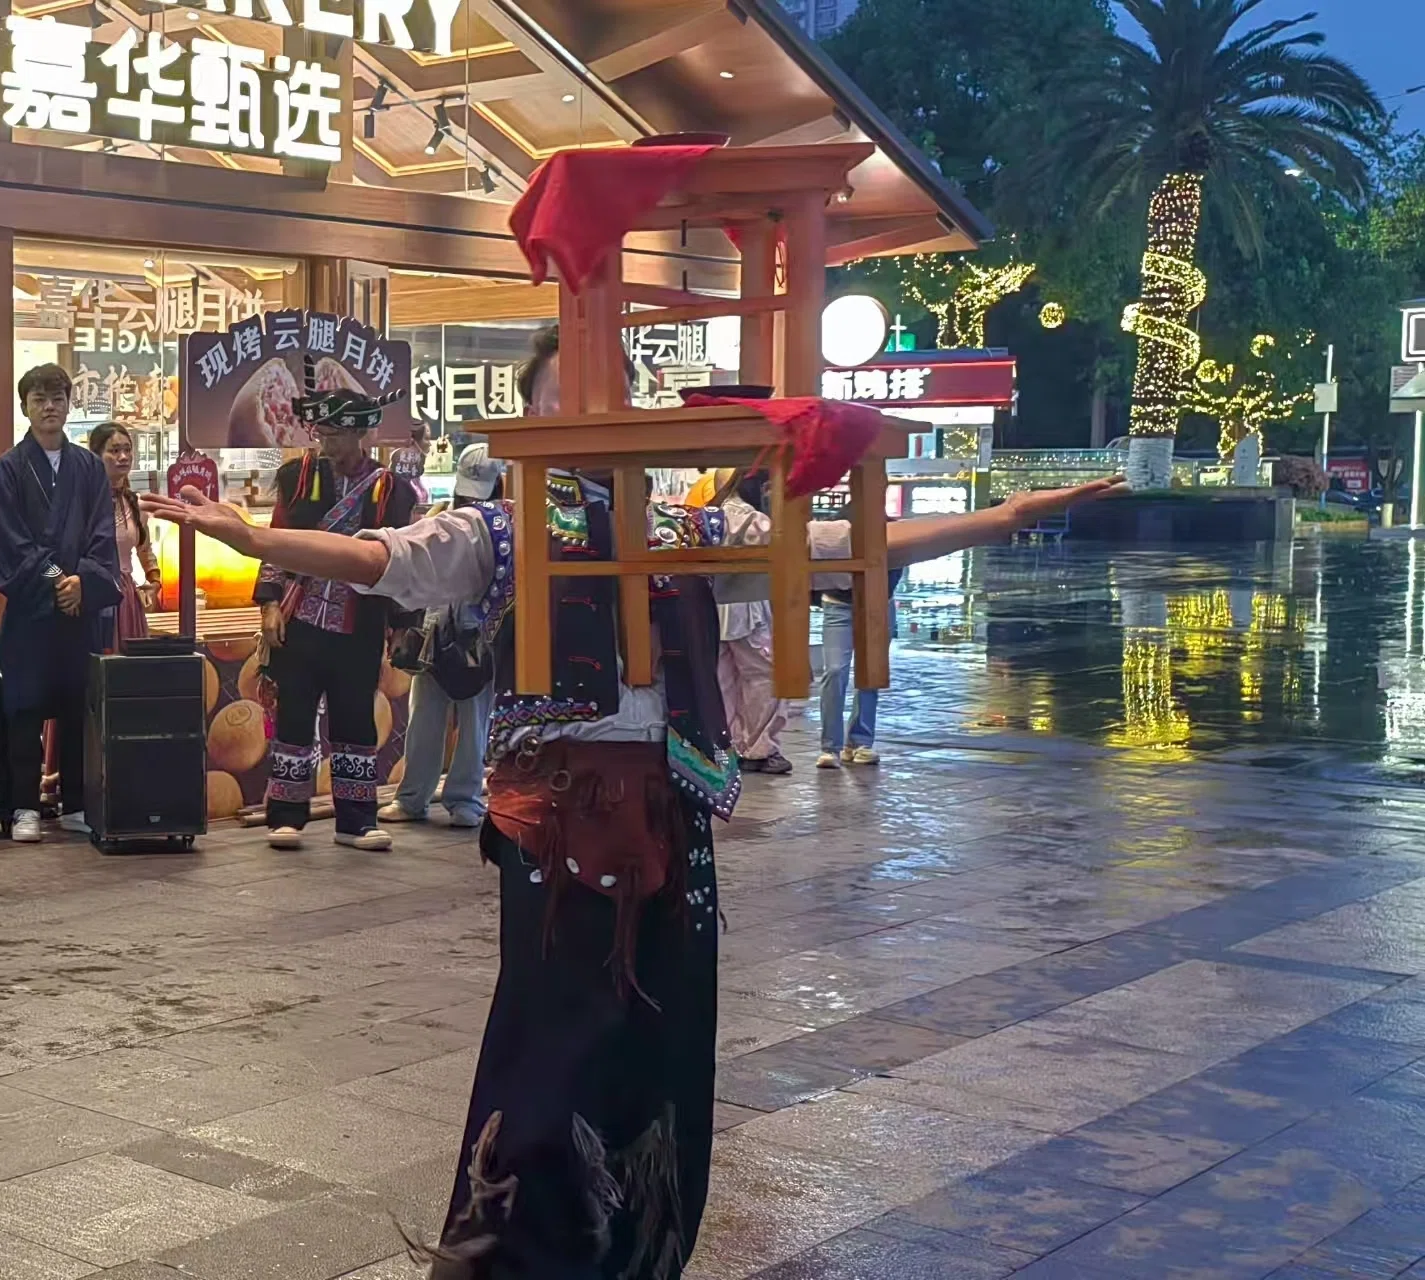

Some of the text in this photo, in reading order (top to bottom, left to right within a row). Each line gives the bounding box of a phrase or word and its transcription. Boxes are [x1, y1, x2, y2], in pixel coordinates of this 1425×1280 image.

[1, 15, 341, 162] 嘉华甄选
[194, 316, 395, 390] 现烤云腿月饼
